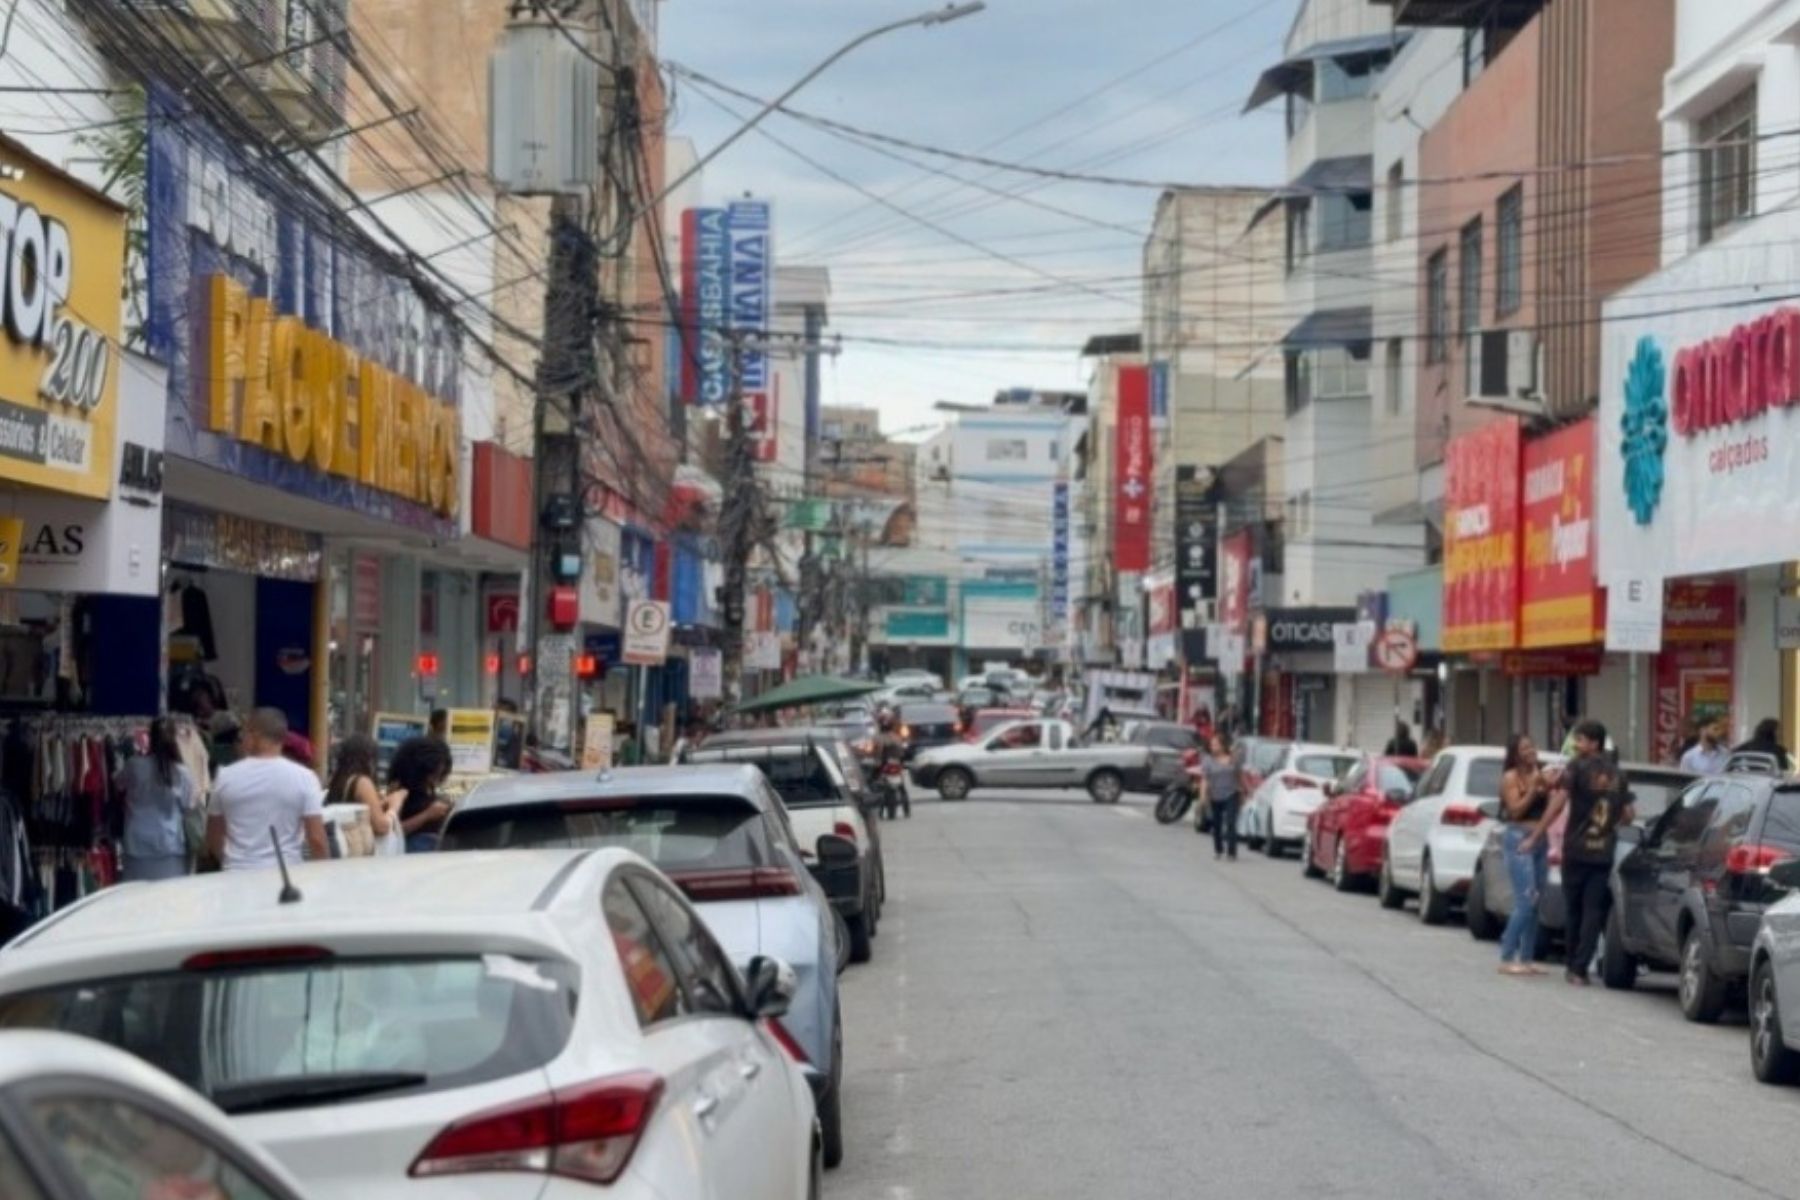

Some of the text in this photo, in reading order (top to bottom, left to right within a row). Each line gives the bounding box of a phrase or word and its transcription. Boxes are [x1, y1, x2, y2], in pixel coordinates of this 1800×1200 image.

[42, 317, 110, 408] 200
[1709, 434, 1768, 474] calçados
[641, 609, 654, 628] E
